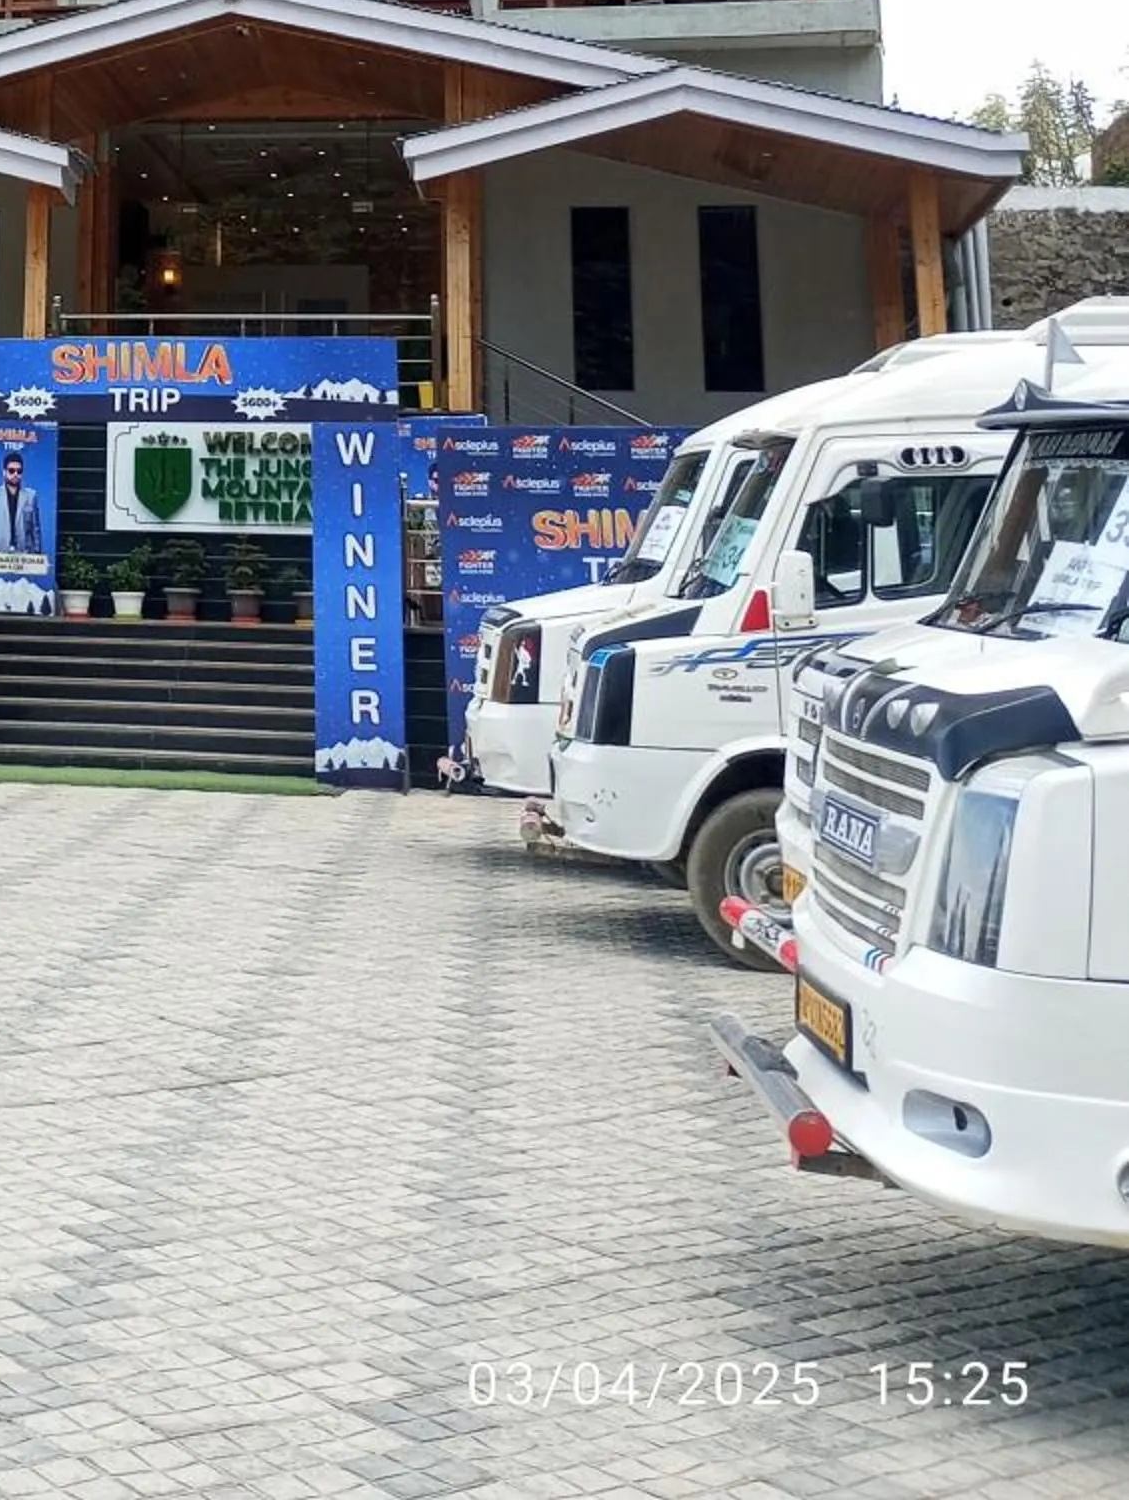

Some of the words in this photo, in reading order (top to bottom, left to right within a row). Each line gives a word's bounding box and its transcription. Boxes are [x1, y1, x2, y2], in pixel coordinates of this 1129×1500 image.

[51, 341, 233, 386] SHIMLA
[107, 387, 182, 413] TRIP
[202, 431, 312, 456] WELCO
[199, 457, 246, 479] THE
[252, 457, 312, 479] JUNG
[200, 479, 313, 500] MOUNTA
[219, 500, 313, 522] RETREA
[531, 508, 649, 550] SHIM
[335, 431, 381, 726] WINNER
[822, 804, 875, 857] RANA
